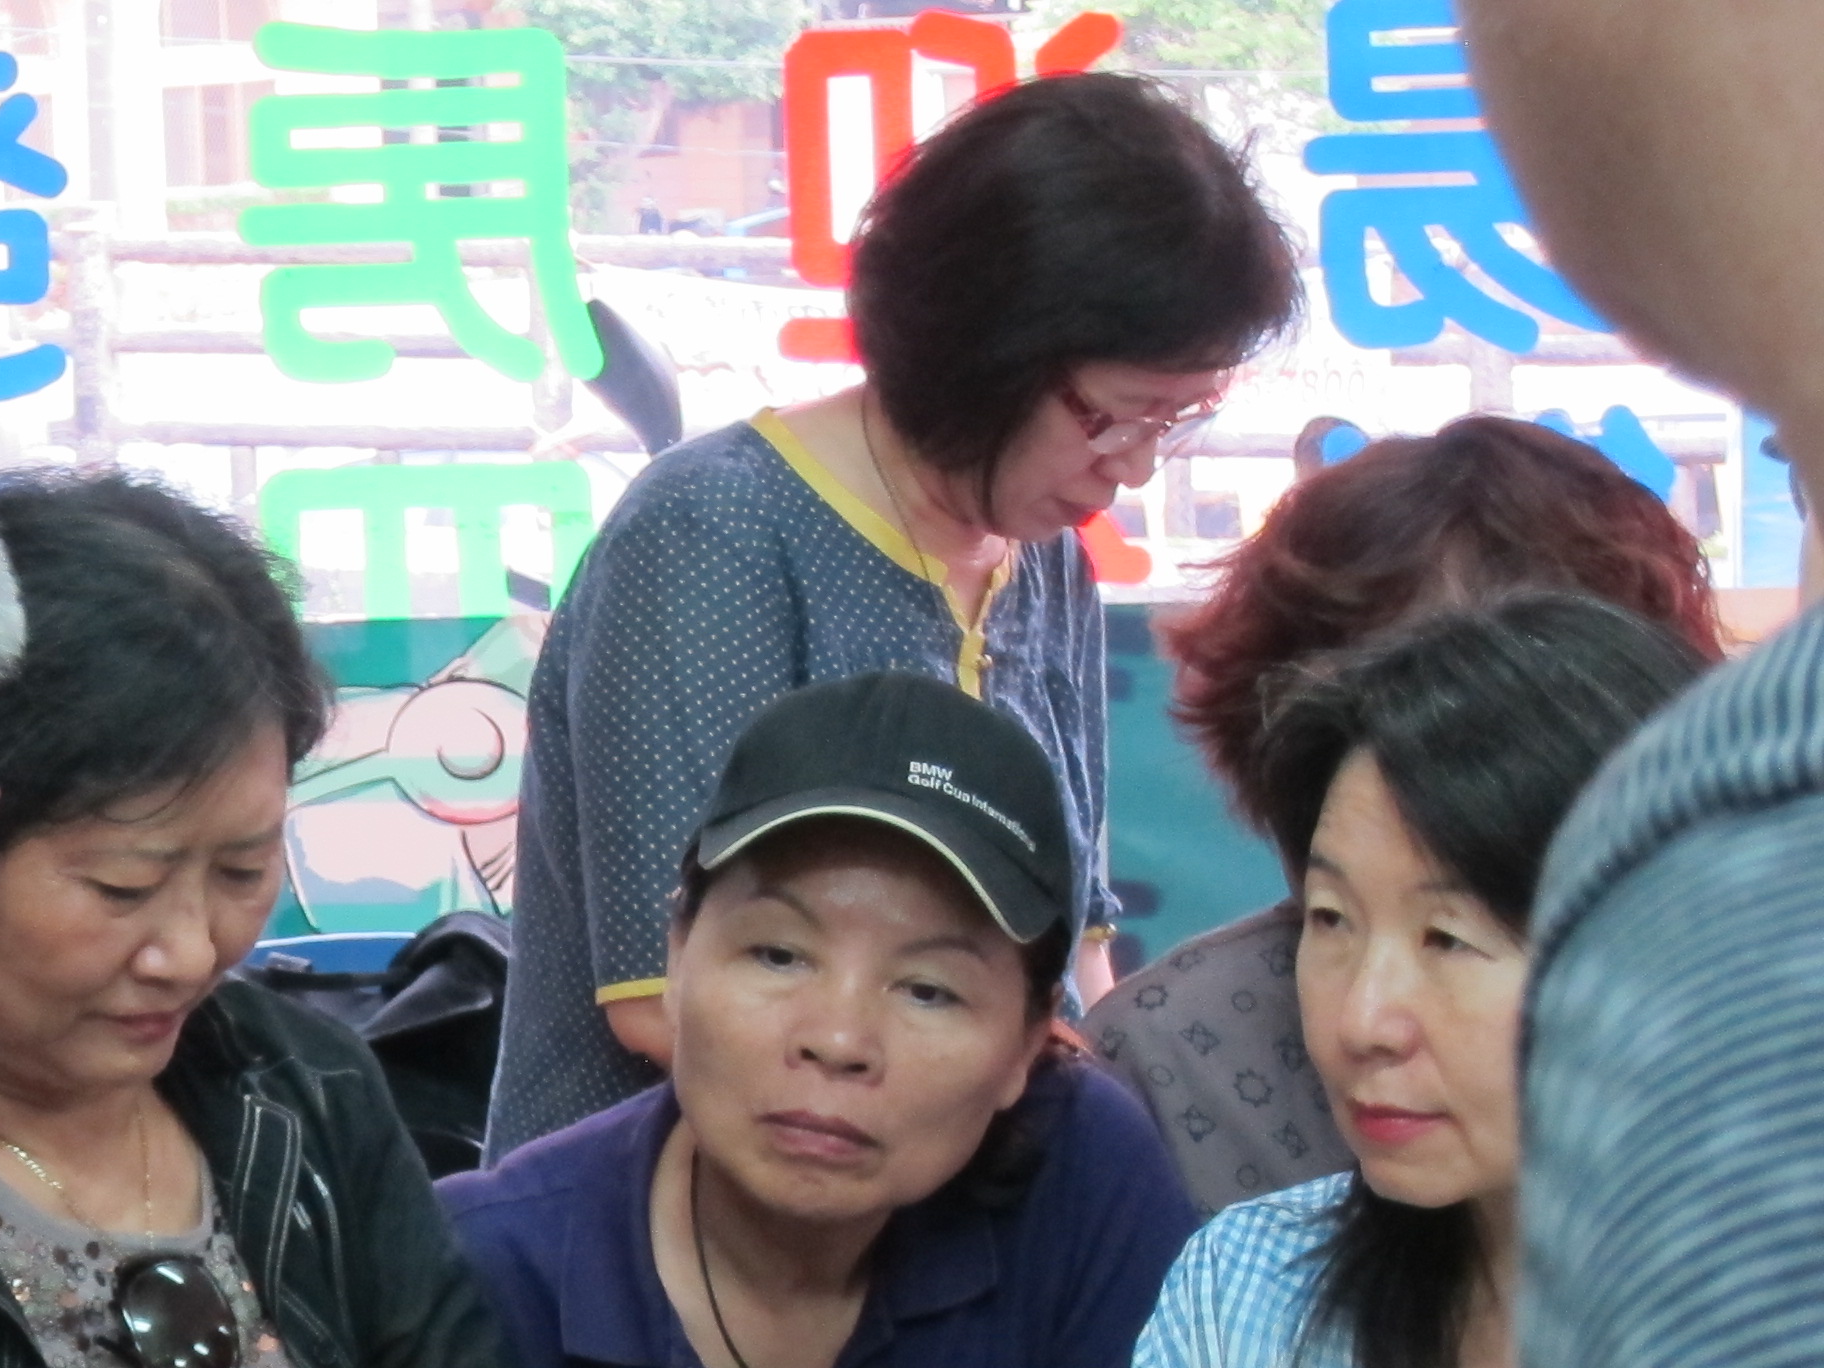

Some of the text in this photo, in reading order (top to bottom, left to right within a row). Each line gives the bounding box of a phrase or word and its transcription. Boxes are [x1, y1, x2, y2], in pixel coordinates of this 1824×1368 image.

[909, 761, 953, 780] BMW
[907, 774, 941, 790] Golf
[942, 782, 971, 803] Cup
